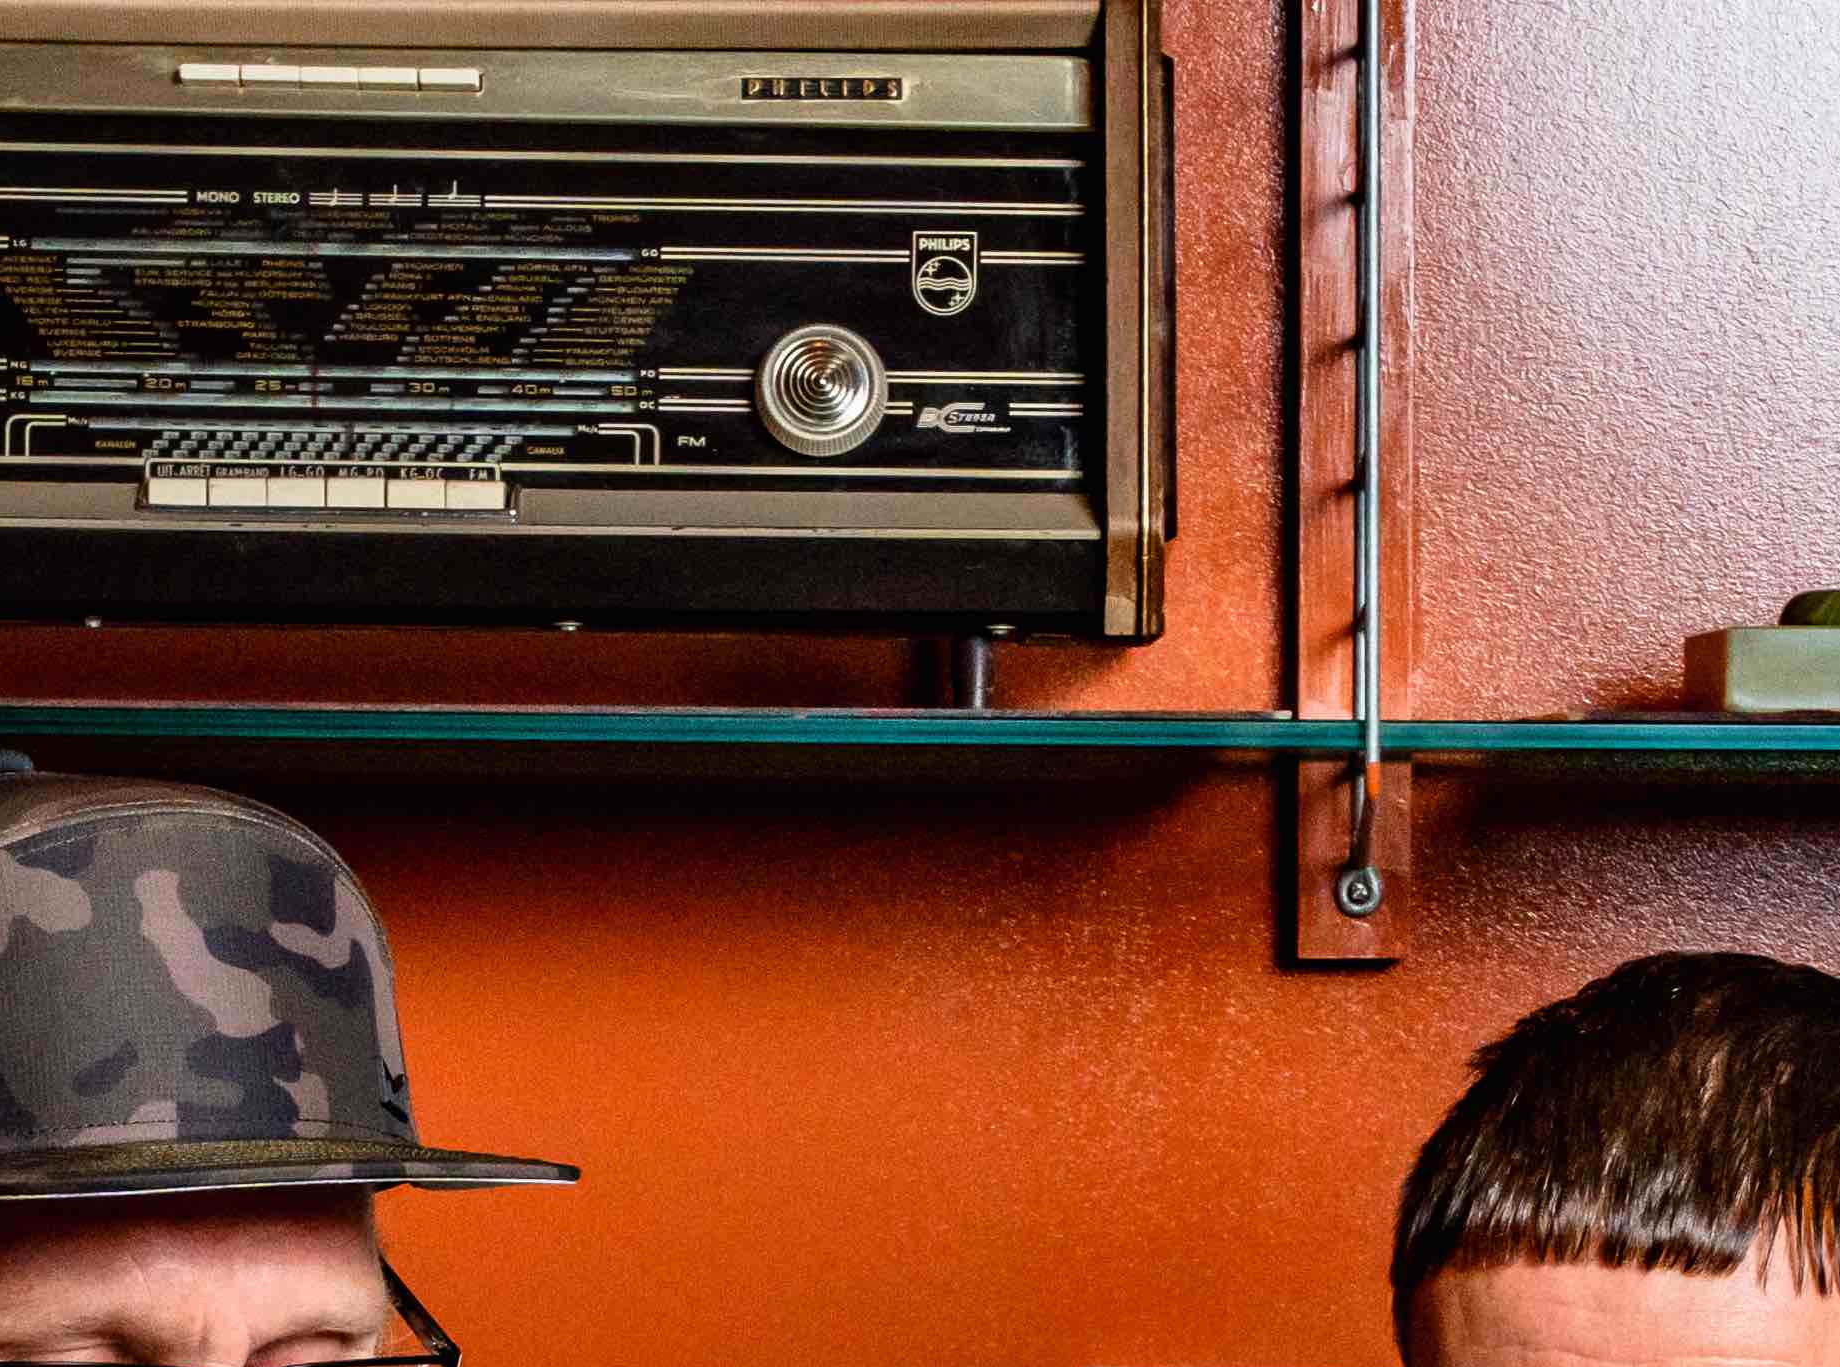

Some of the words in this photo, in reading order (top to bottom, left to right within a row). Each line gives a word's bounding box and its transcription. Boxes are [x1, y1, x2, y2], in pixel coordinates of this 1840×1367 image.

[196, 191, 239, 203] MONO
[253, 192, 300, 204] STEREO
[918, 238, 971, 251] PHILIPS
[9, 361, 28, 369] MG
[144, 378, 173, 389] 20
[254, 379, 282, 391] 25
[408, 382, 436, 393] 30
[511, 384, 537, 395] 40
[9, 391, 26, 400] KG
[639, 401, 656, 410] OC
[677, 435, 706, 448] FM
[469, 468, 488, 480] FM
